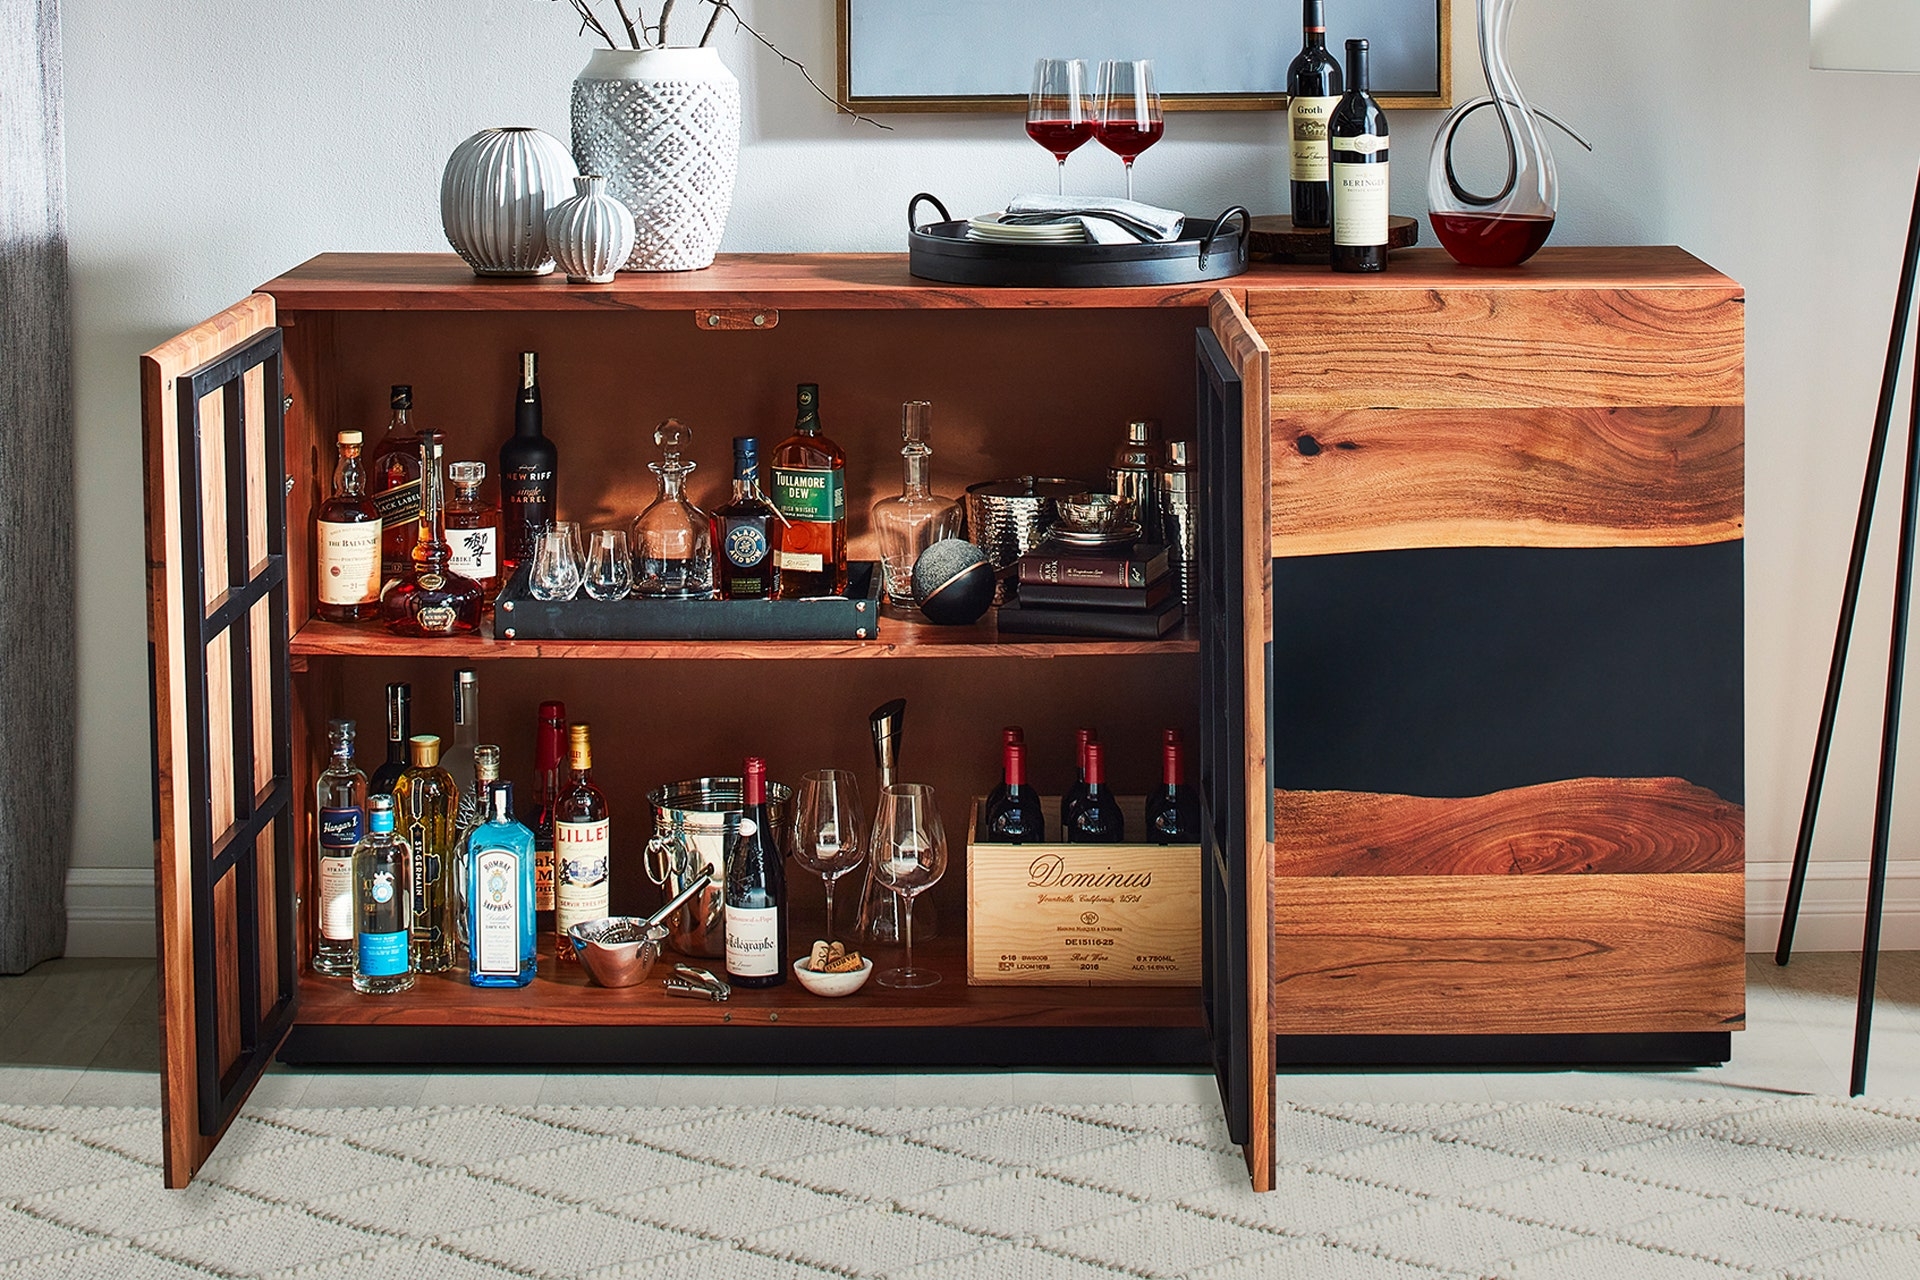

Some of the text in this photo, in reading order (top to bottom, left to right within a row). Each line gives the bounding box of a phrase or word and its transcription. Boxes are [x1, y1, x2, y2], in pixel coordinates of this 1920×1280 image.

[1297, 105, 1323, 114] Groth
[506, 471, 552, 481] NEW RIFF
[775, 472, 826, 489] TULLAMORE
[517, 486, 541, 498] single
[789, 488, 809, 499] DEW
[381, 493, 421, 512] ACK LABEL
[731, 529, 760, 541] BLADE
[729, 549, 762, 564] AND BOW
[1050, 560, 1058, 583] BOOK
[323, 821, 351, 833] Hangar
[559, 825, 609, 843] LILLET
[483, 860, 511, 873] BOMBAY
[1028, 854, 1152, 888] Dominus
[482, 899, 513, 911] SAPPHIRE
